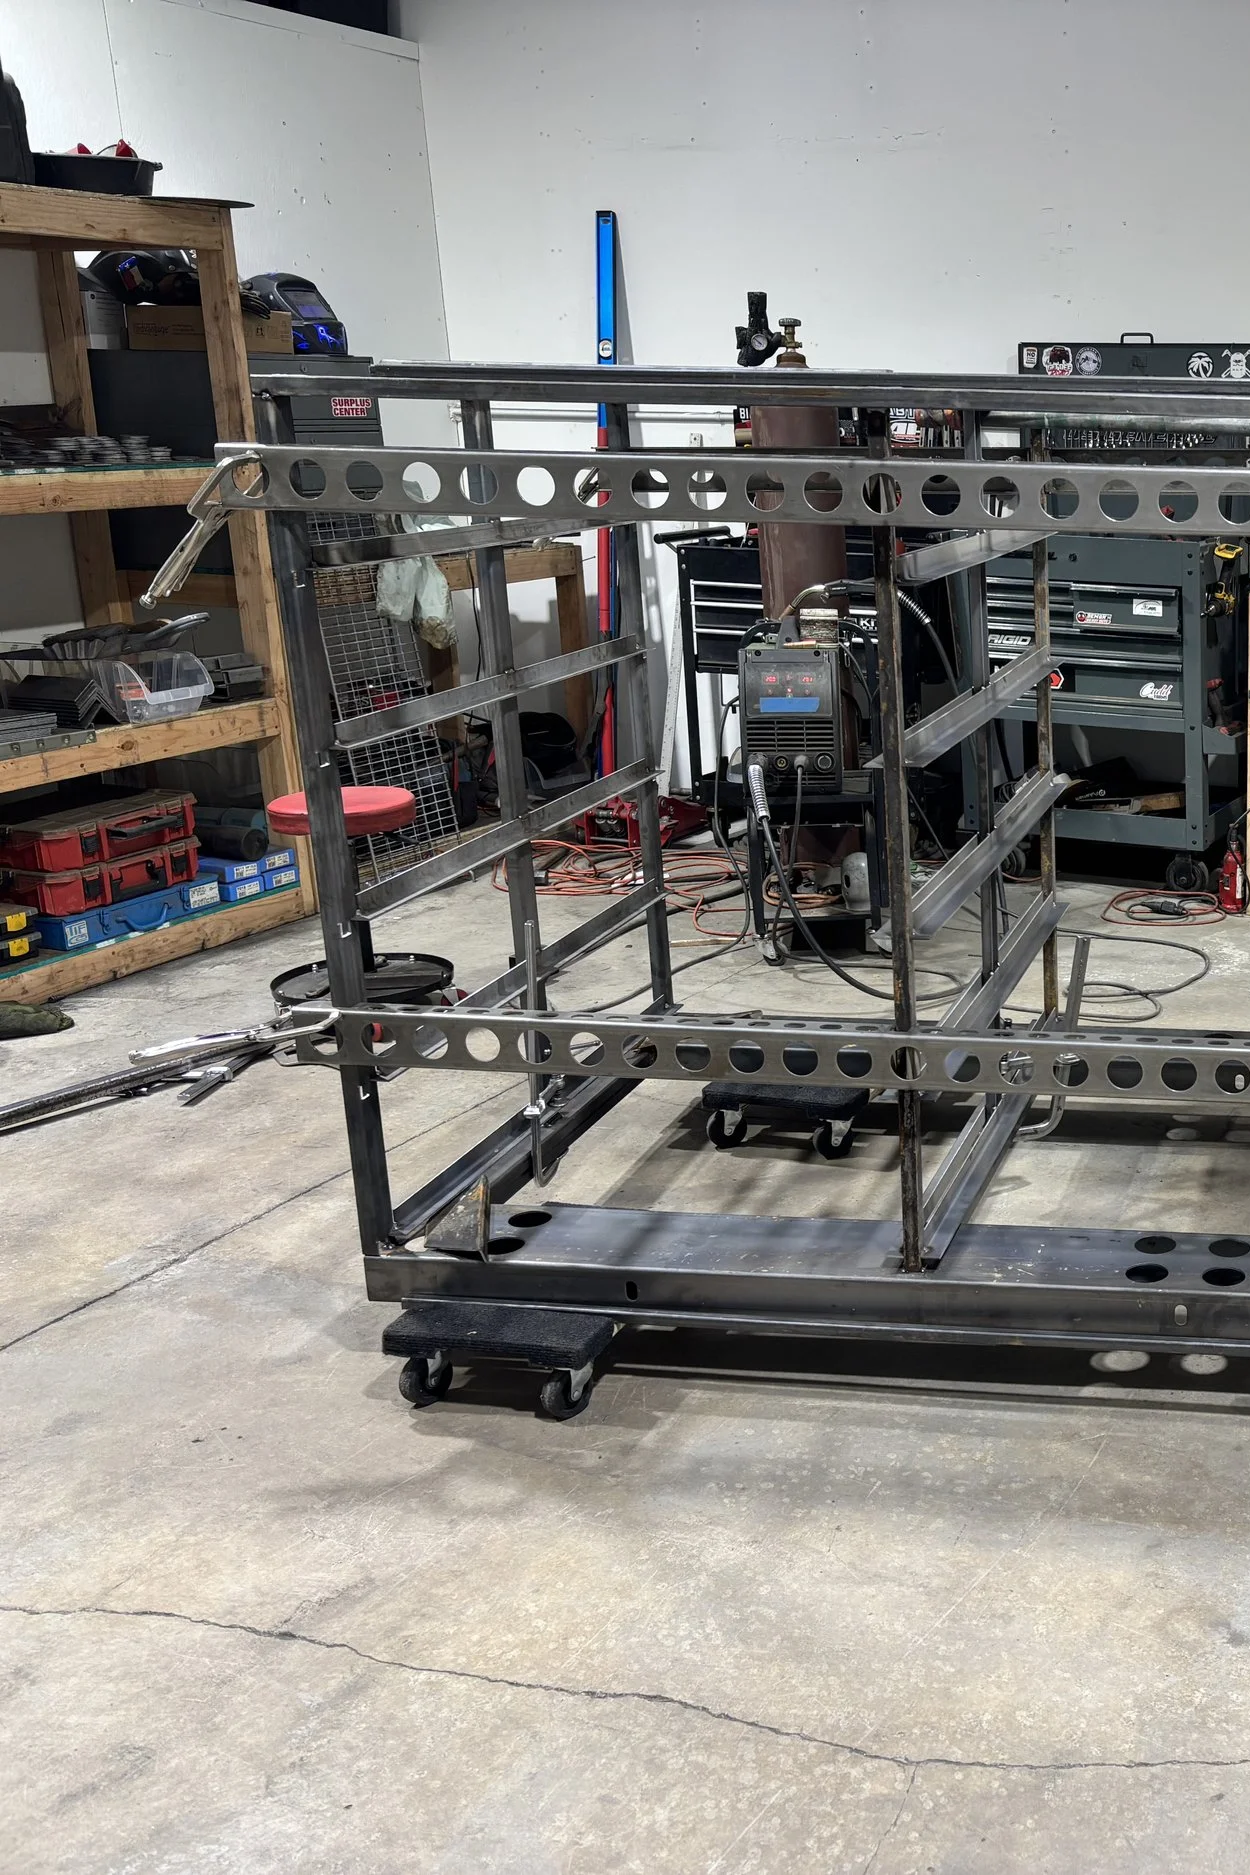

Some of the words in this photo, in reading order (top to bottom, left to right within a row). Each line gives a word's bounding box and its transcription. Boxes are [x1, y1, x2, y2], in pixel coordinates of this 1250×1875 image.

[332, 398, 371, 407] SURPLUS
[333, 407, 366, 416] CENTER
[988, 634, 1031, 645] RIGID
